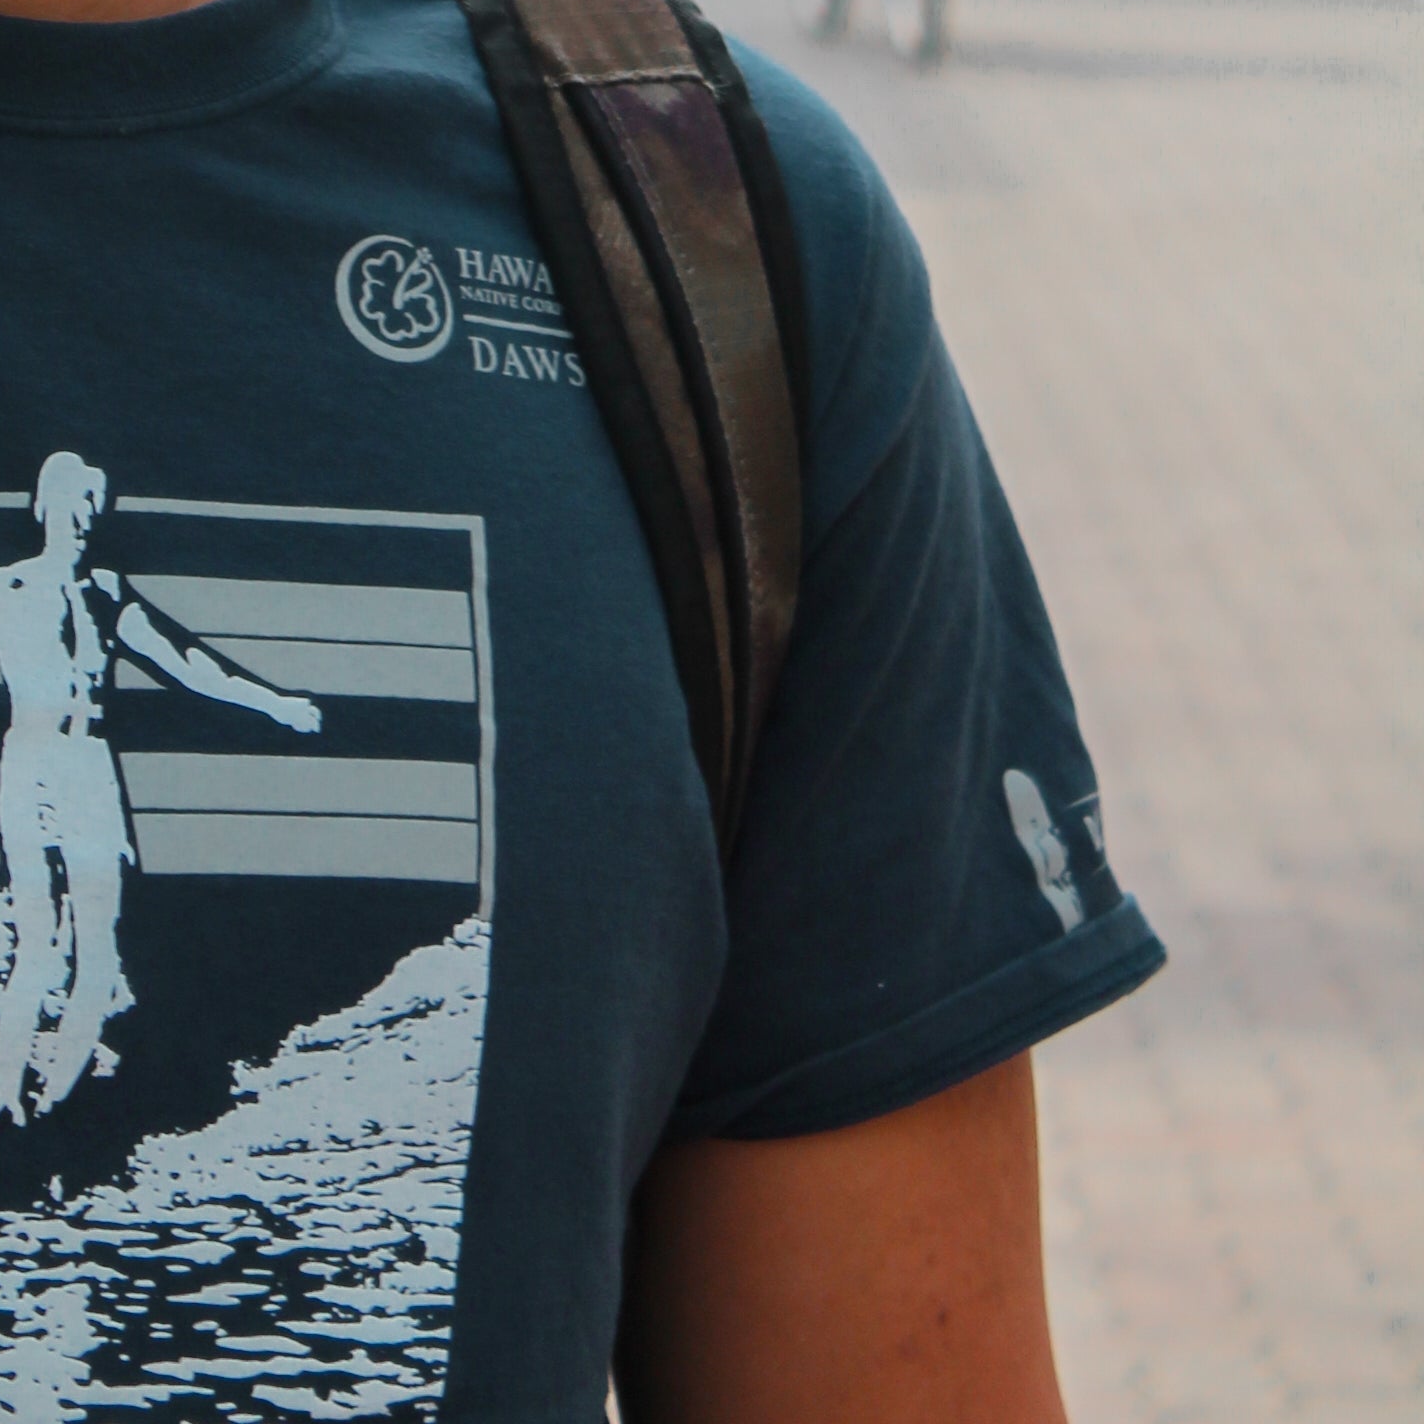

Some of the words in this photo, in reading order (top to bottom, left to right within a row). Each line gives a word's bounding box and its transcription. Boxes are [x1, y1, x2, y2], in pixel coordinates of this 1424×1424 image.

[455, 247, 555, 295] HAWA
[458, 284, 519, 309] NATIVE
[467, 335, 586, 387] DAWS
